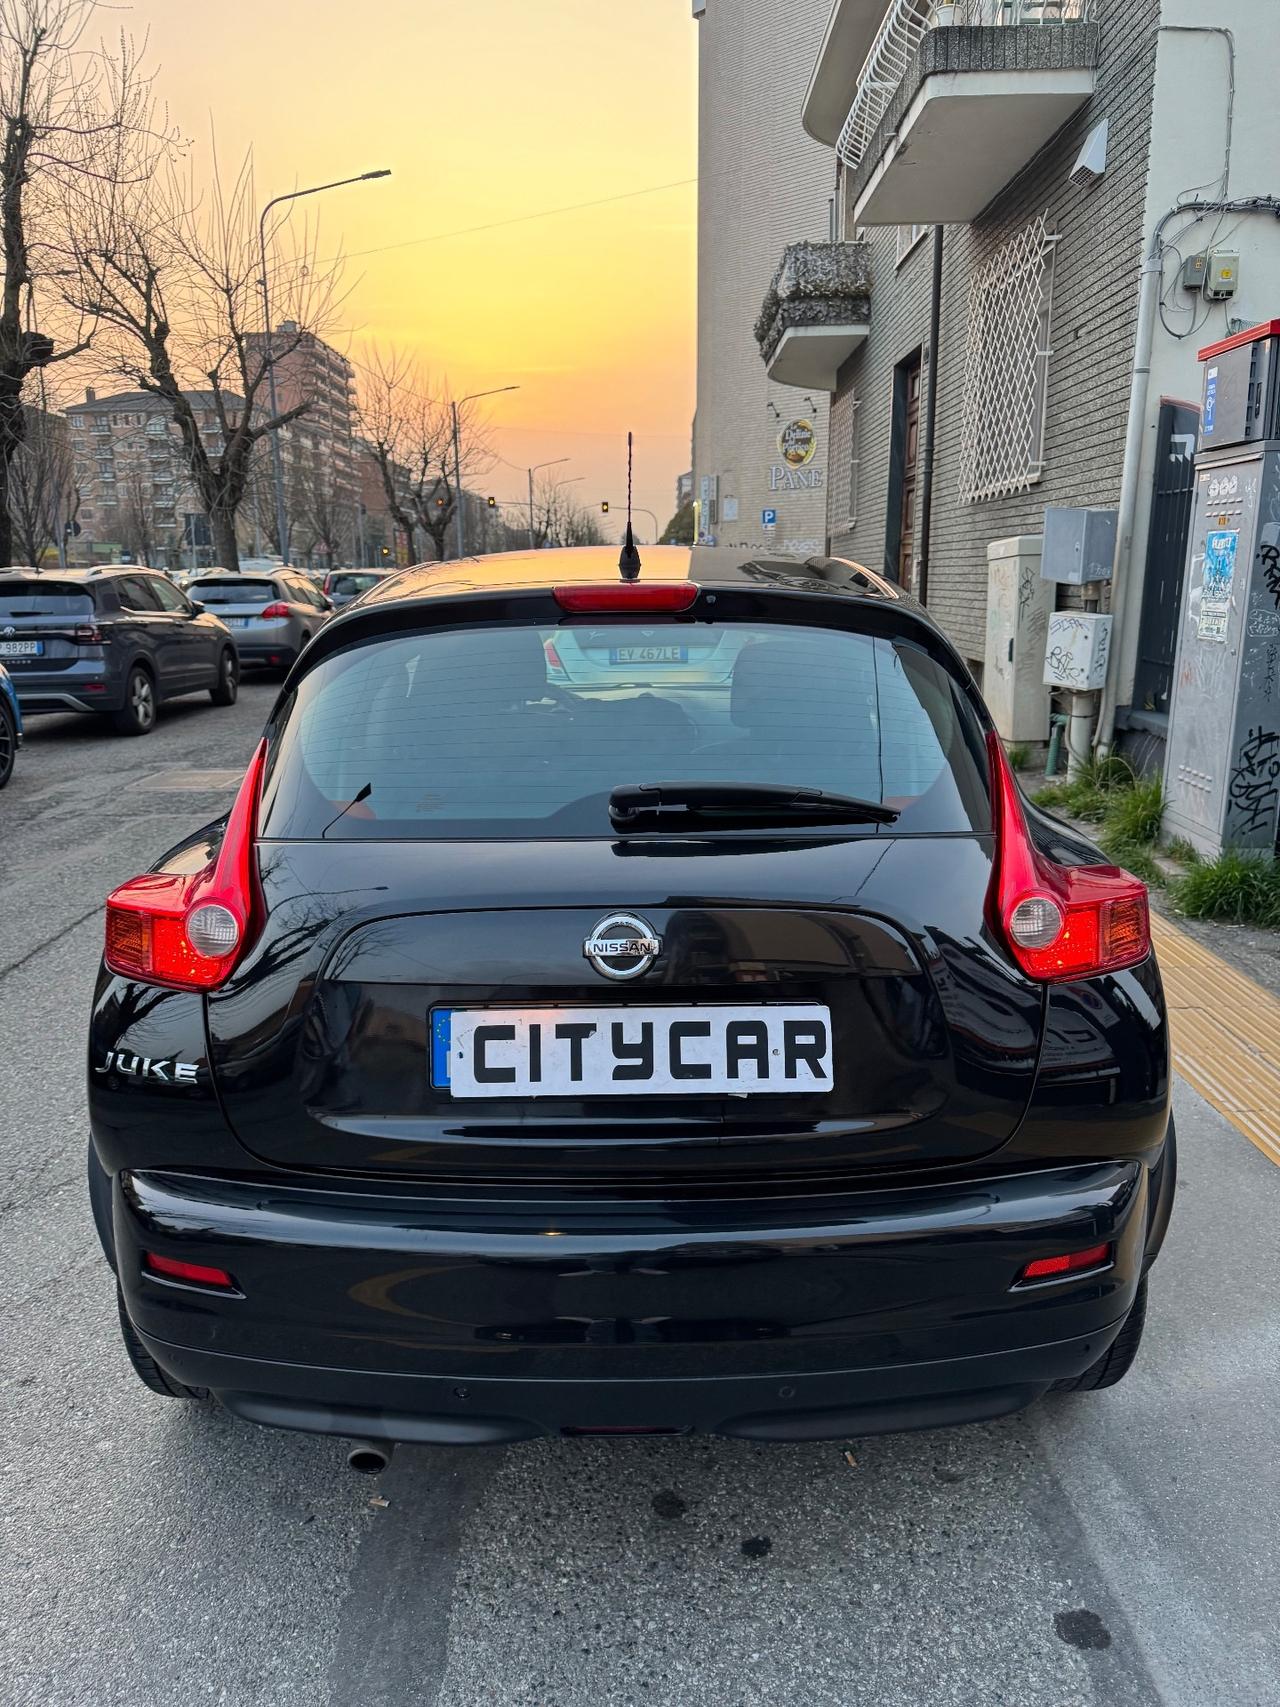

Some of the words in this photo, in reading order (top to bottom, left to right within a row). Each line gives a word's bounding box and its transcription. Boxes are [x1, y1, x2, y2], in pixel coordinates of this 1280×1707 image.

[764, 511, 774, 523] P
[640, 647, 679, 660] 467LE
[593, 942, 651, 953] NISSAN
[473, 1020, 828, 1084] CITYCAR
[95, 1051, 200, 1084] JUKE
